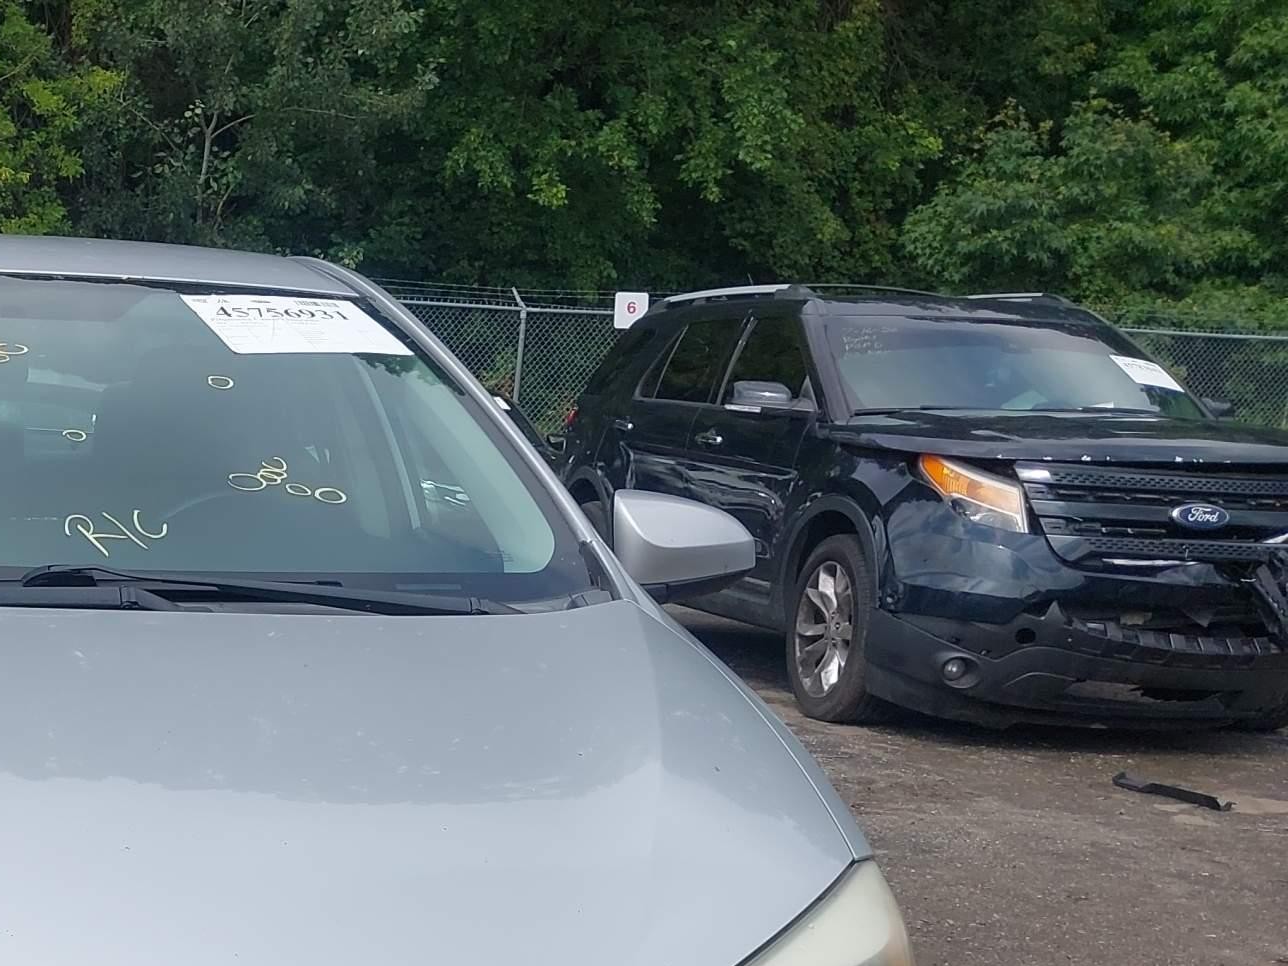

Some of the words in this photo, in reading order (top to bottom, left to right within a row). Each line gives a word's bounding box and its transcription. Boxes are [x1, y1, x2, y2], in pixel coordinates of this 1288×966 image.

[215, 306, 350, 321] 45756931
[626, 301, 637, 314] 6
[1187, 506, 1220, 522] Ford
